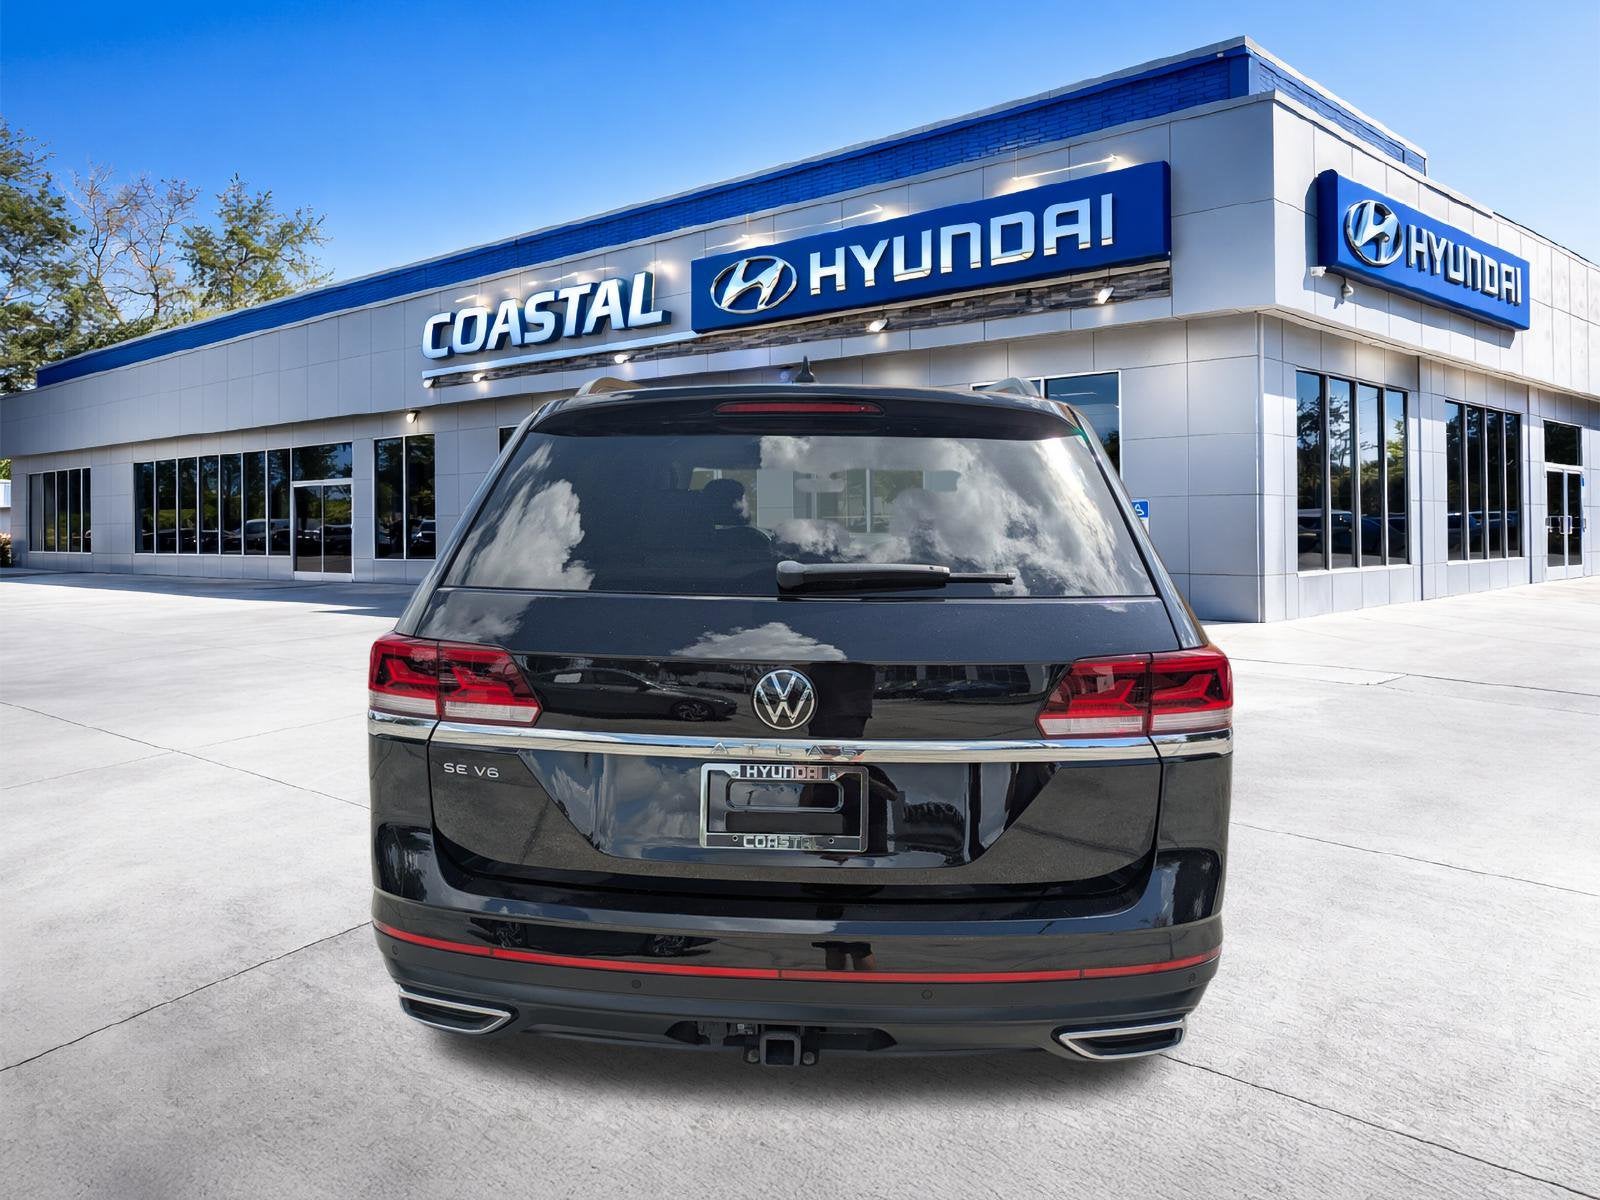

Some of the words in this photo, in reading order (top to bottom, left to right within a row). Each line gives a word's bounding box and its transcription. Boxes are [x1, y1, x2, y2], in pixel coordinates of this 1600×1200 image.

[810, 193, 1113, 295] HYUNDAI
[1407, 225, 1522, 305] HYUNDAI
[422, 271, 668, 359] COASTAL
[443, 762, 468, 775] SE
[474, 765, 499, 778] V6
[711, 742, 858, 759] ATLAS
